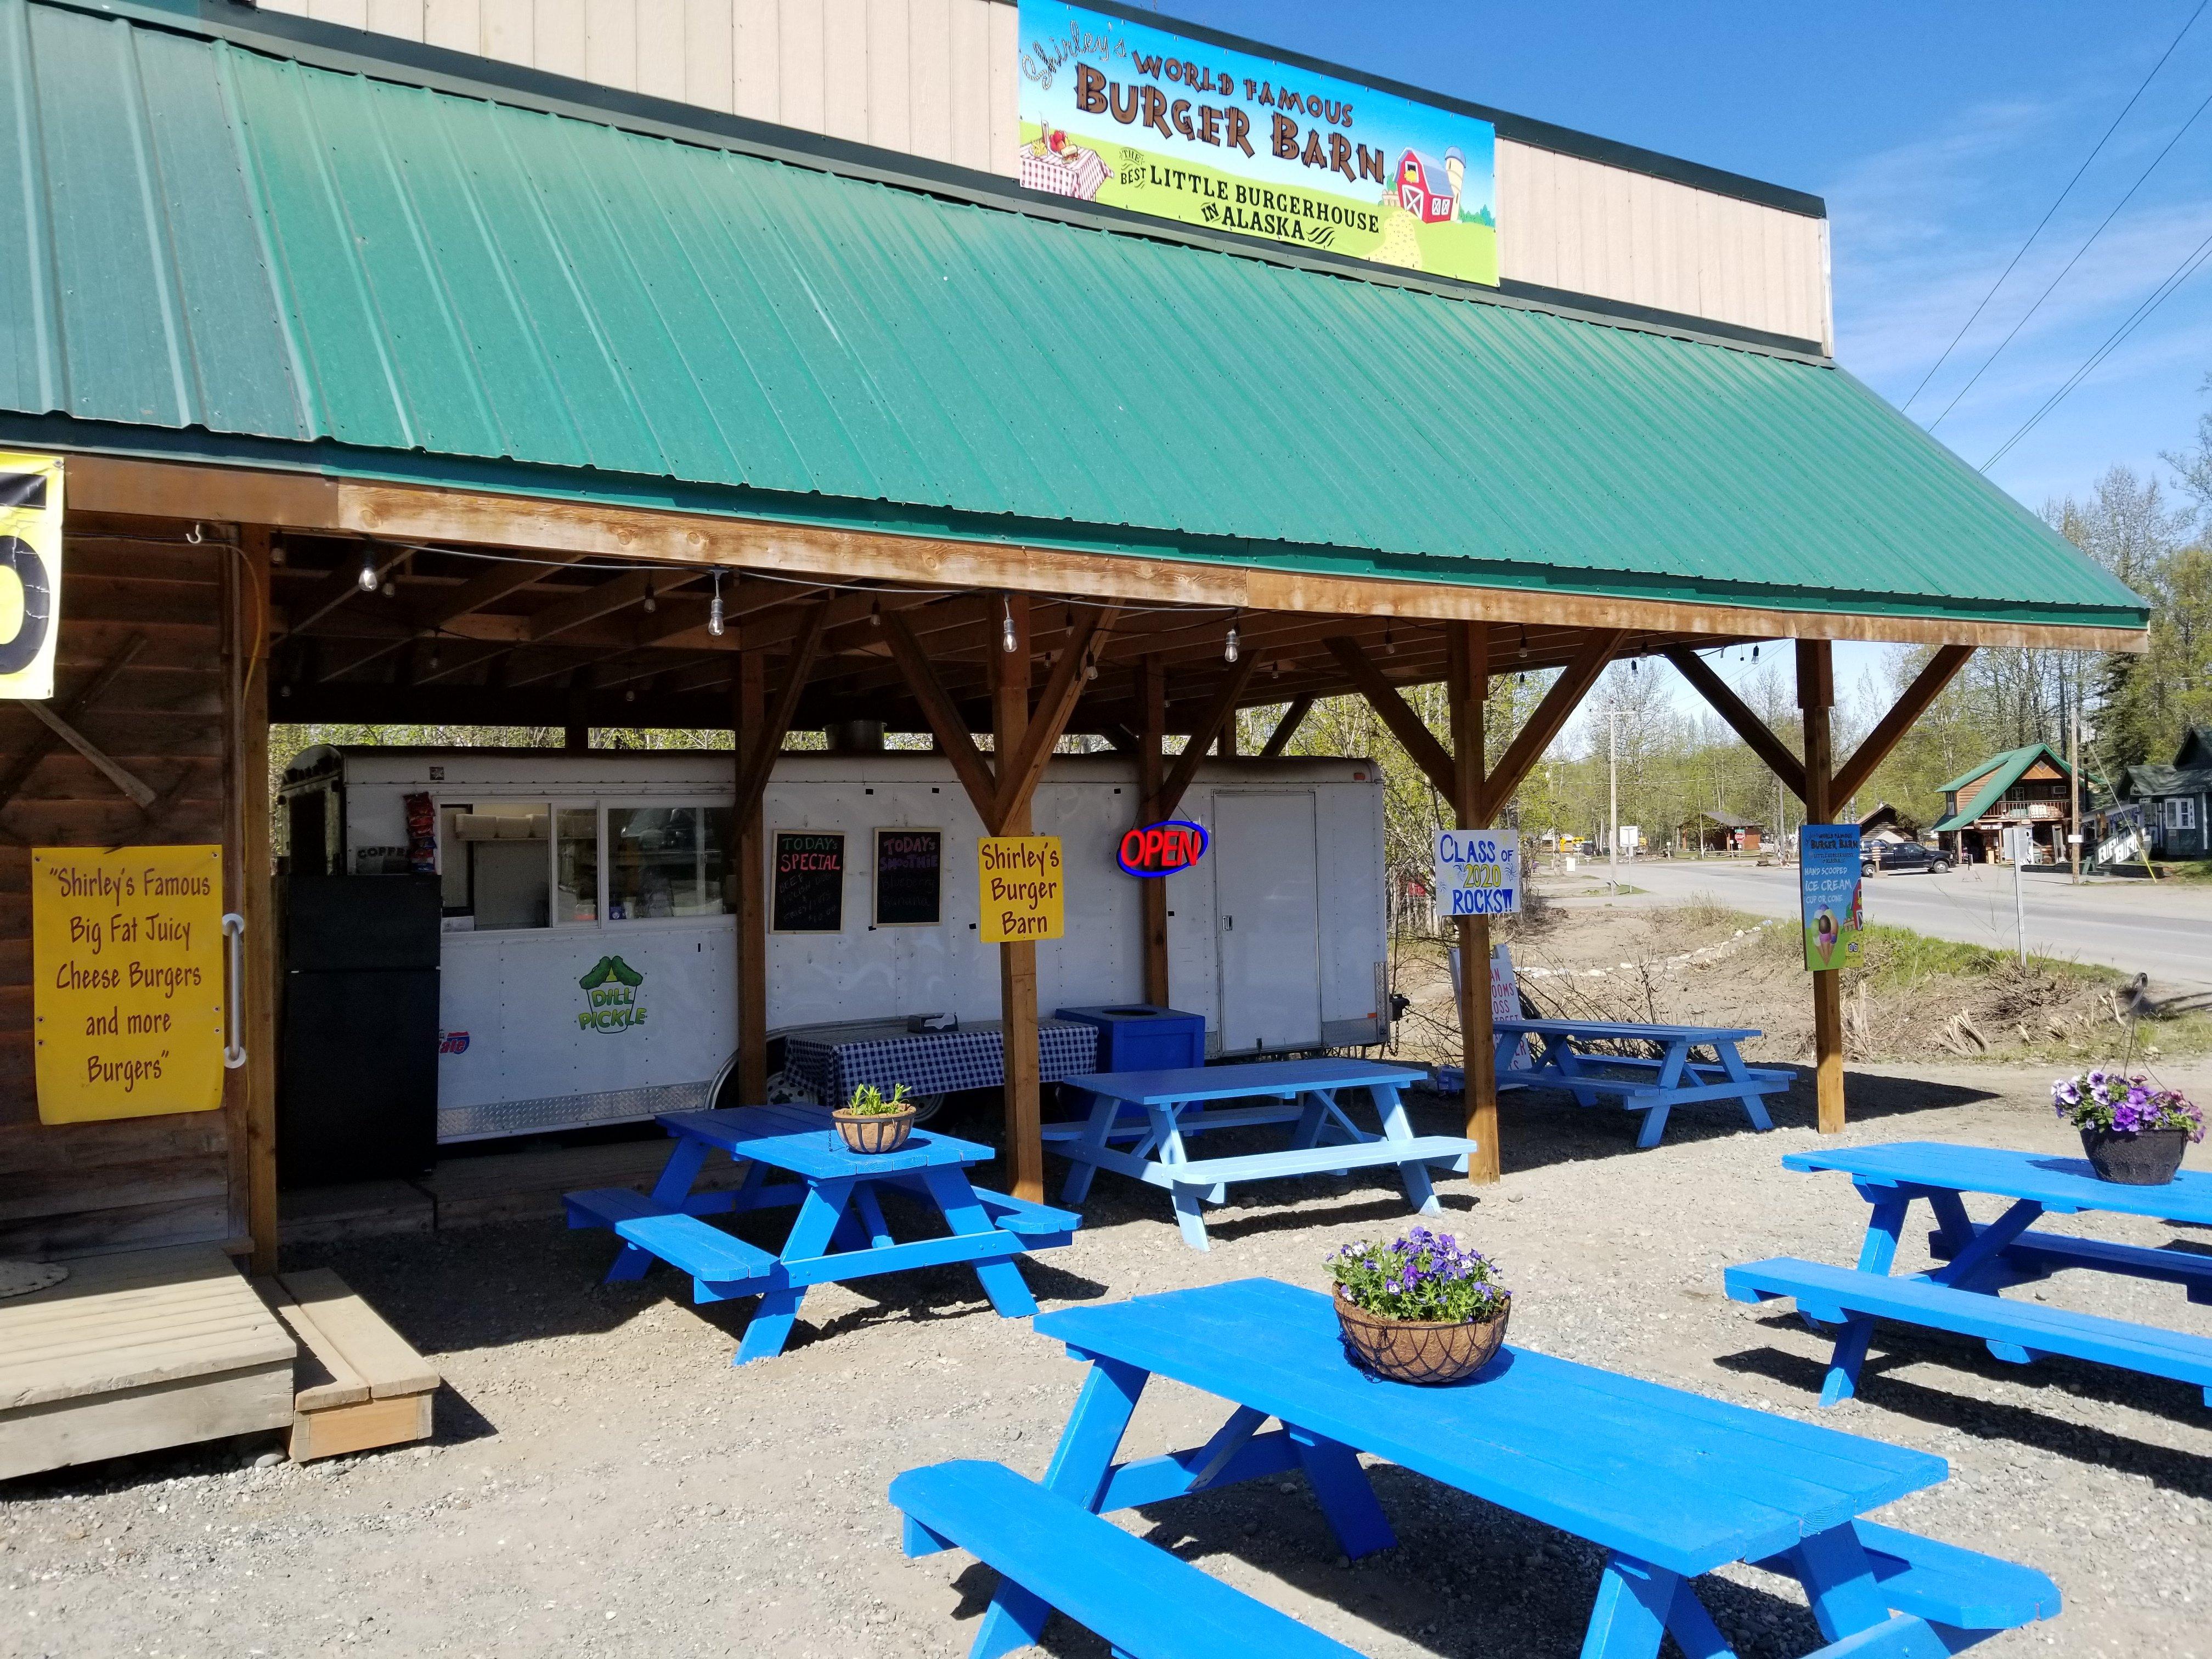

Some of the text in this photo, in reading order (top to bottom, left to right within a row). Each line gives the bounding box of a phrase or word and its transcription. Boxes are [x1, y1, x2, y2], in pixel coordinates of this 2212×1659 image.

[1022, 20, 1127, 89] Shirley's
[1132, 49, 1353, 127] WORLD FAMOUS
[1075, 61, 1385, 184] BURGER BARN
[1121, 149, 1142, 165] THE
[1121, 168, 1146, 185] BEST
[1150, 165, 1379, 234] LITTLE BURGERHOUSE
[1201, 201, 1305, 240] IN ALASKA
[358, 847, 406, 859] COFFE
[981, 842, 1059, 877] Shirley's
[1121, 829, 1200, 867] OPEN
[1440, 834, 1514, 863] CLASS OF
[781, 853, 840, 872] SPECIAL
[1804, 867, 1847, 876] HAND SCOOPED
[49, 867, 211, 906] "Shirley's Famous
[1463, 864, 1501, 888] 2020
[1805, 878, 1852, 891] ICE CREAM
[991, 877, 1057, 910] Burger
[1452, 889, 1513, 915] ROCKS!!
[1806, 895, 1817, 904] CUP
[1827, 895, 1843, 903] CONE
[70, 912, 191, 955] Big Fat Juicy
[1001, 911, 1047, 935] Barn
[56, 960, 201, 998] Cheese Burgers
[1491, 983, 1515, 998] OOMS
[591, 988, 634, 1007] DILL
[1493, 1000, 1510, 1014] OSS
[86, 1006, 172, 1036] and more
[578, 1007, 647, 1030] PICKLE
